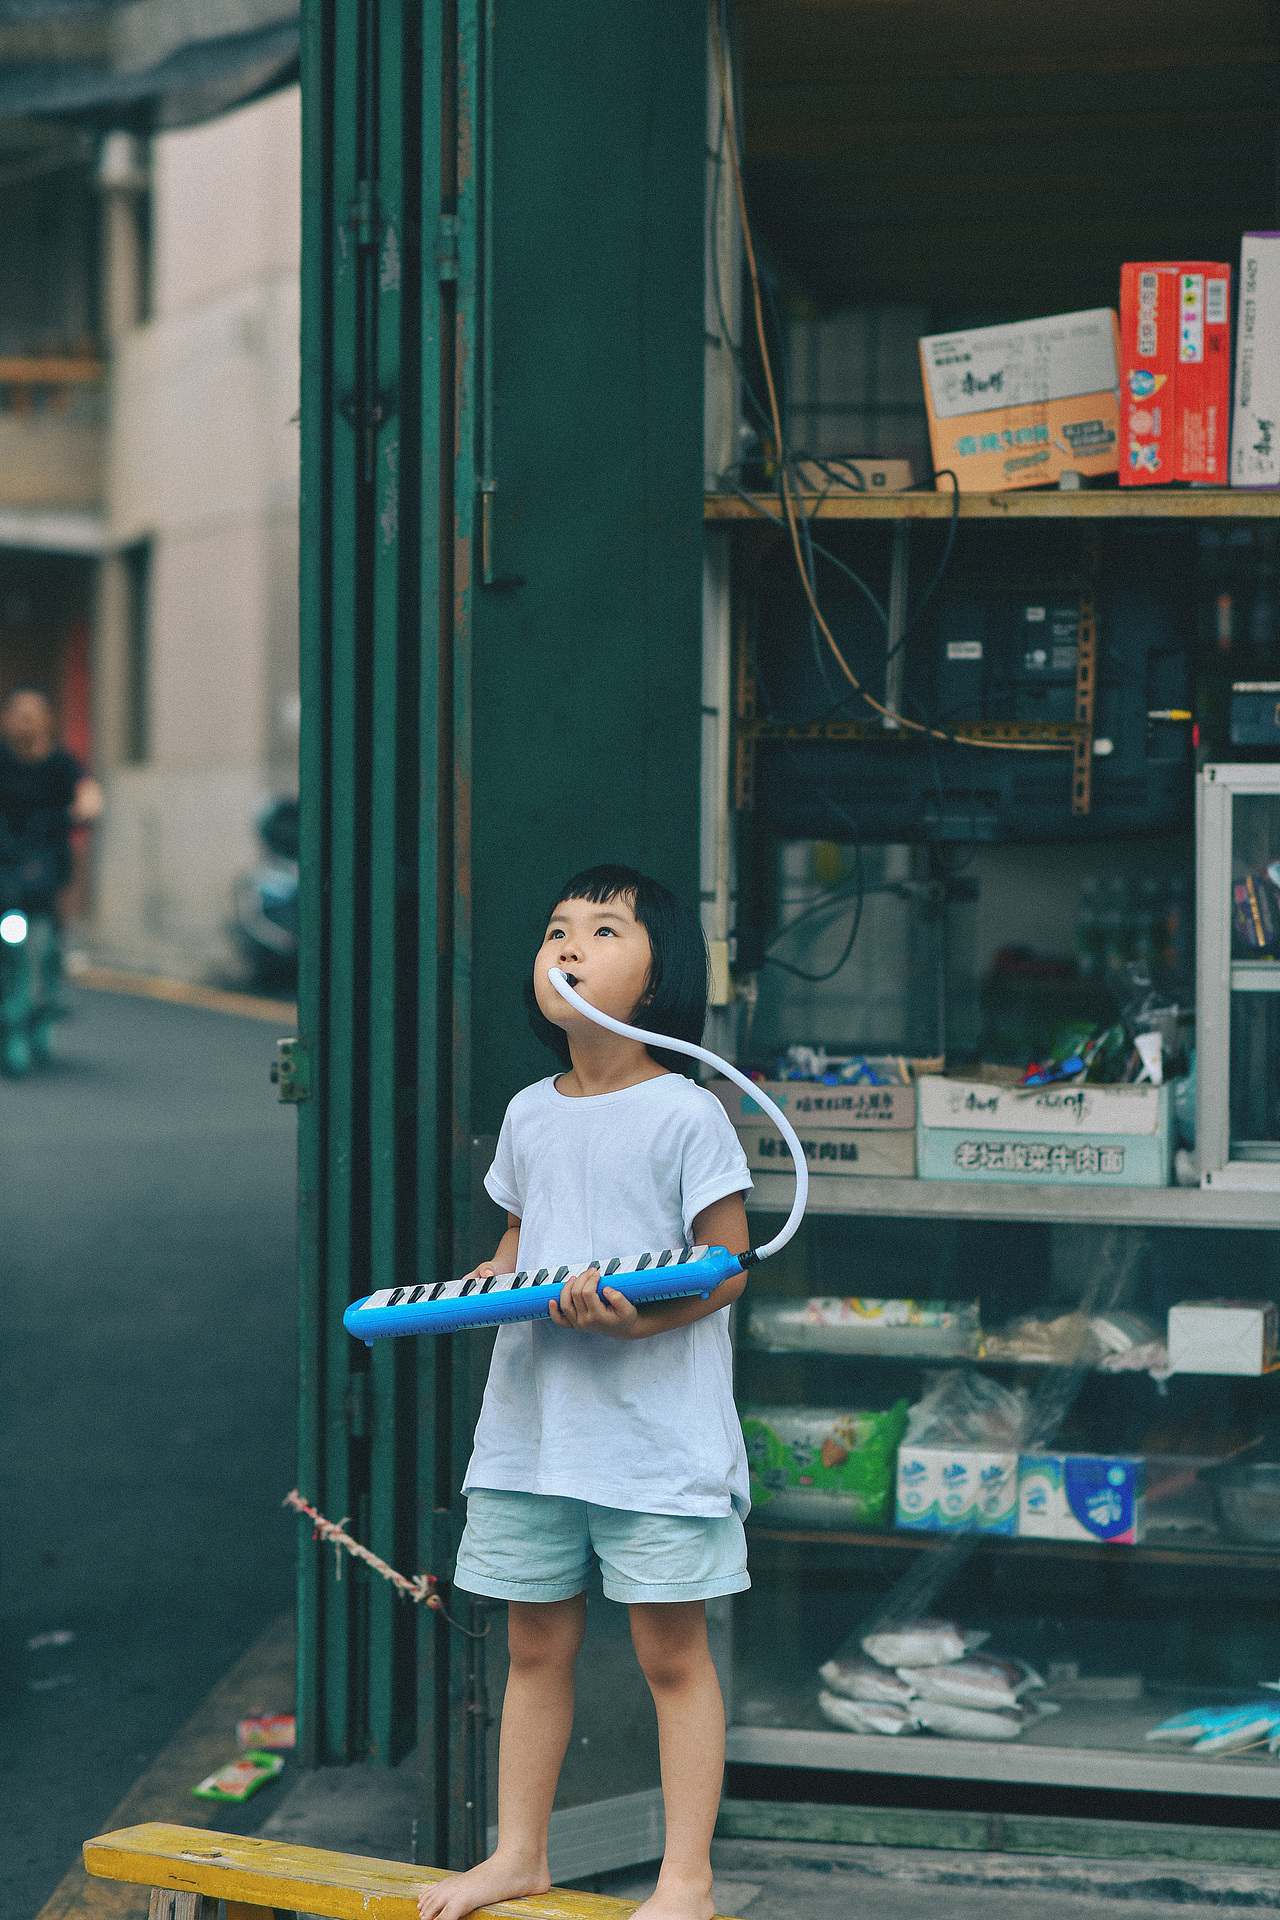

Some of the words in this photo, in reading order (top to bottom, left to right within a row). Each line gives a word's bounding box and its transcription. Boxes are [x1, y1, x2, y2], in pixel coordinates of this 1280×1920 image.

[954, 1138, 1126, 1174] 老坛酸菜牛肉面
